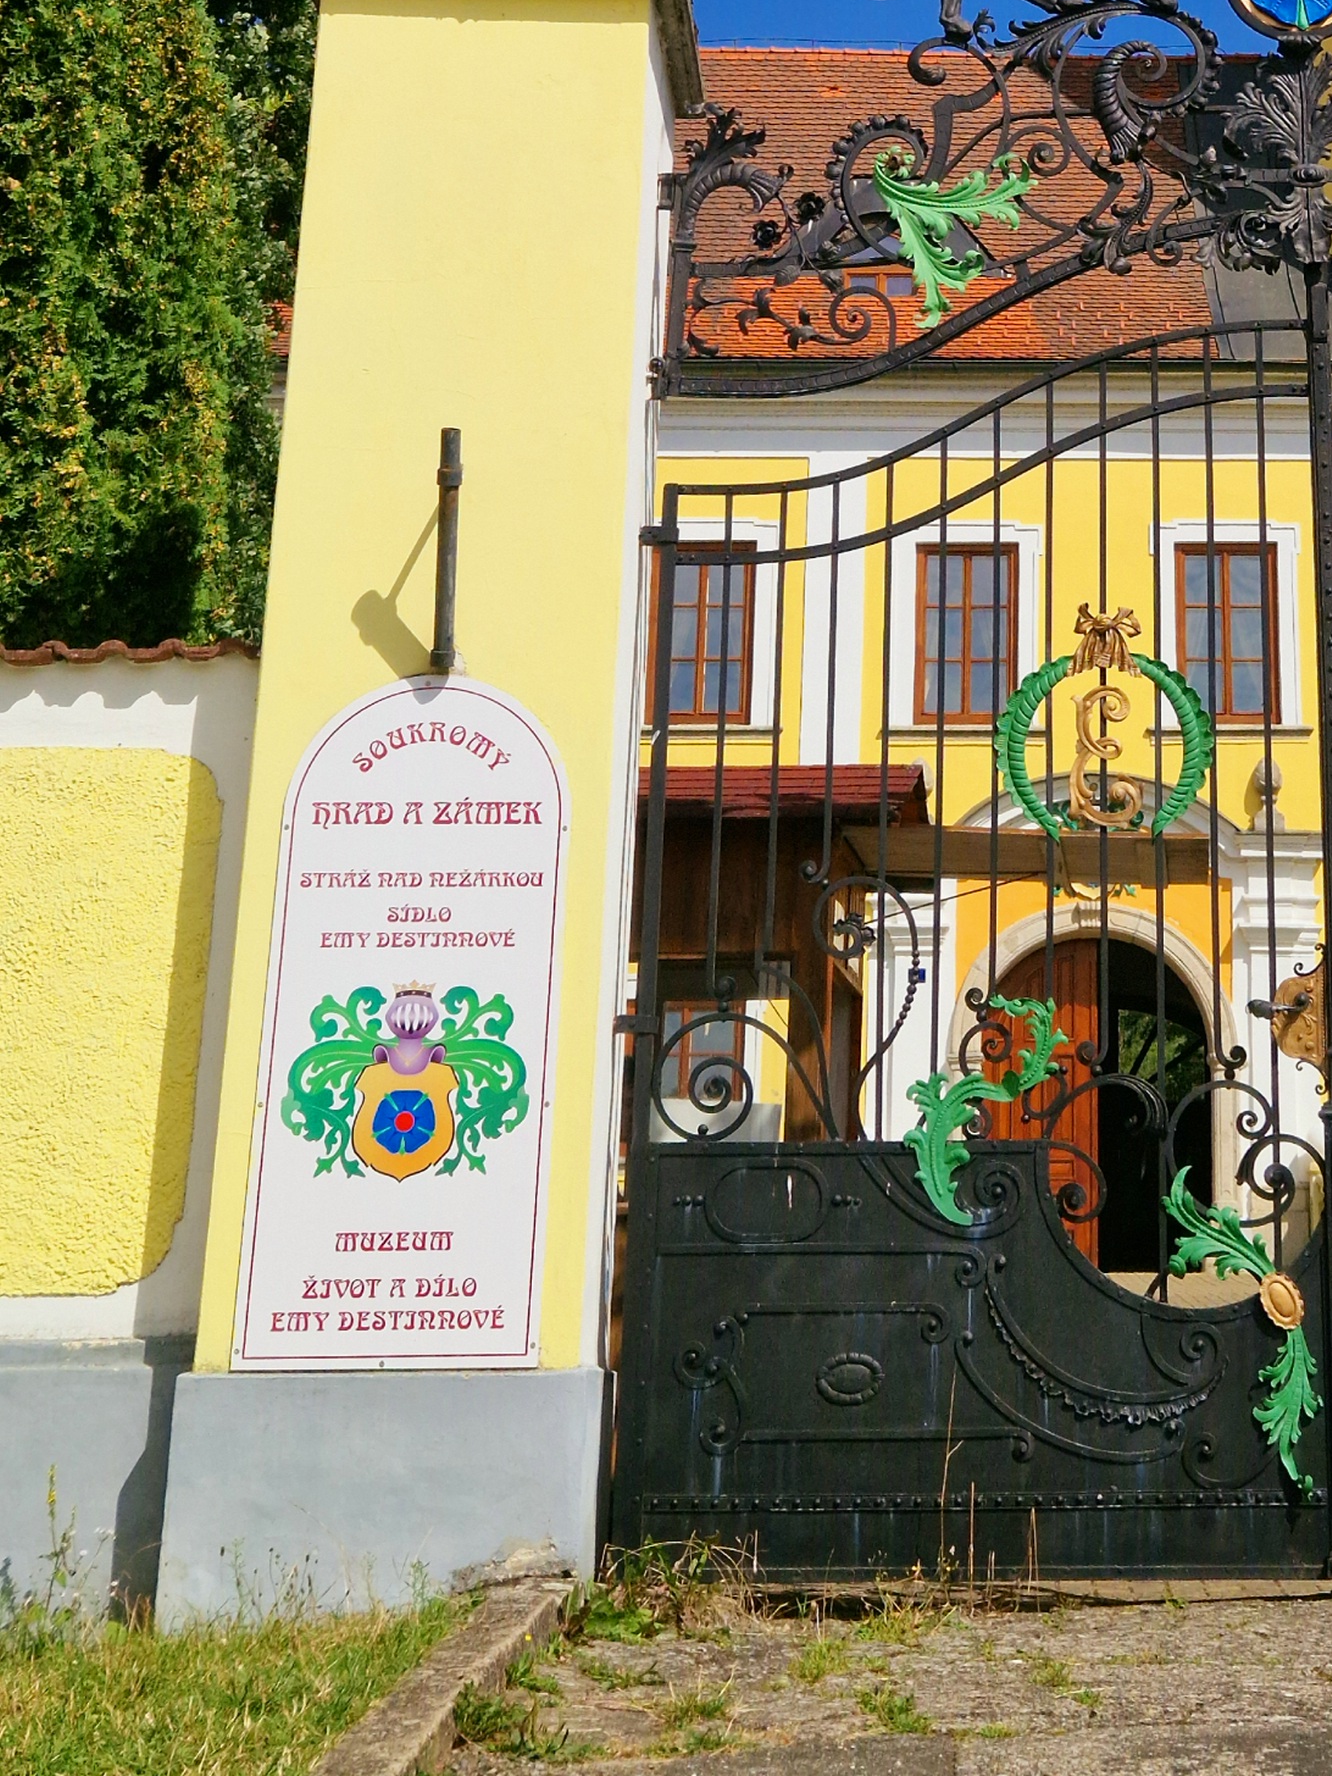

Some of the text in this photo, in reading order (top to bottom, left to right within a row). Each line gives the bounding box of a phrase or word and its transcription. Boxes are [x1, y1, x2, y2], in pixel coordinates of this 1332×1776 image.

[352, 721, 511, 772] SOUKROMÝ
[312, 797, 542, 829] HRAD A ZÁMEK
[300, 869, 543, 888] STRÁŽ NAD NEŽÁRKOU
[387, 904, 451, 922] SÍDLO
[320, 929, 515, 948] EMY DESTINNOVÉ
[336, 1232, 453, 1252] MUZEUM
[302, 1274, 477, 1299] ŽIVOT A DÍLO
[270, 1305, 504, 1332] EMY DESTINNOVÉ
